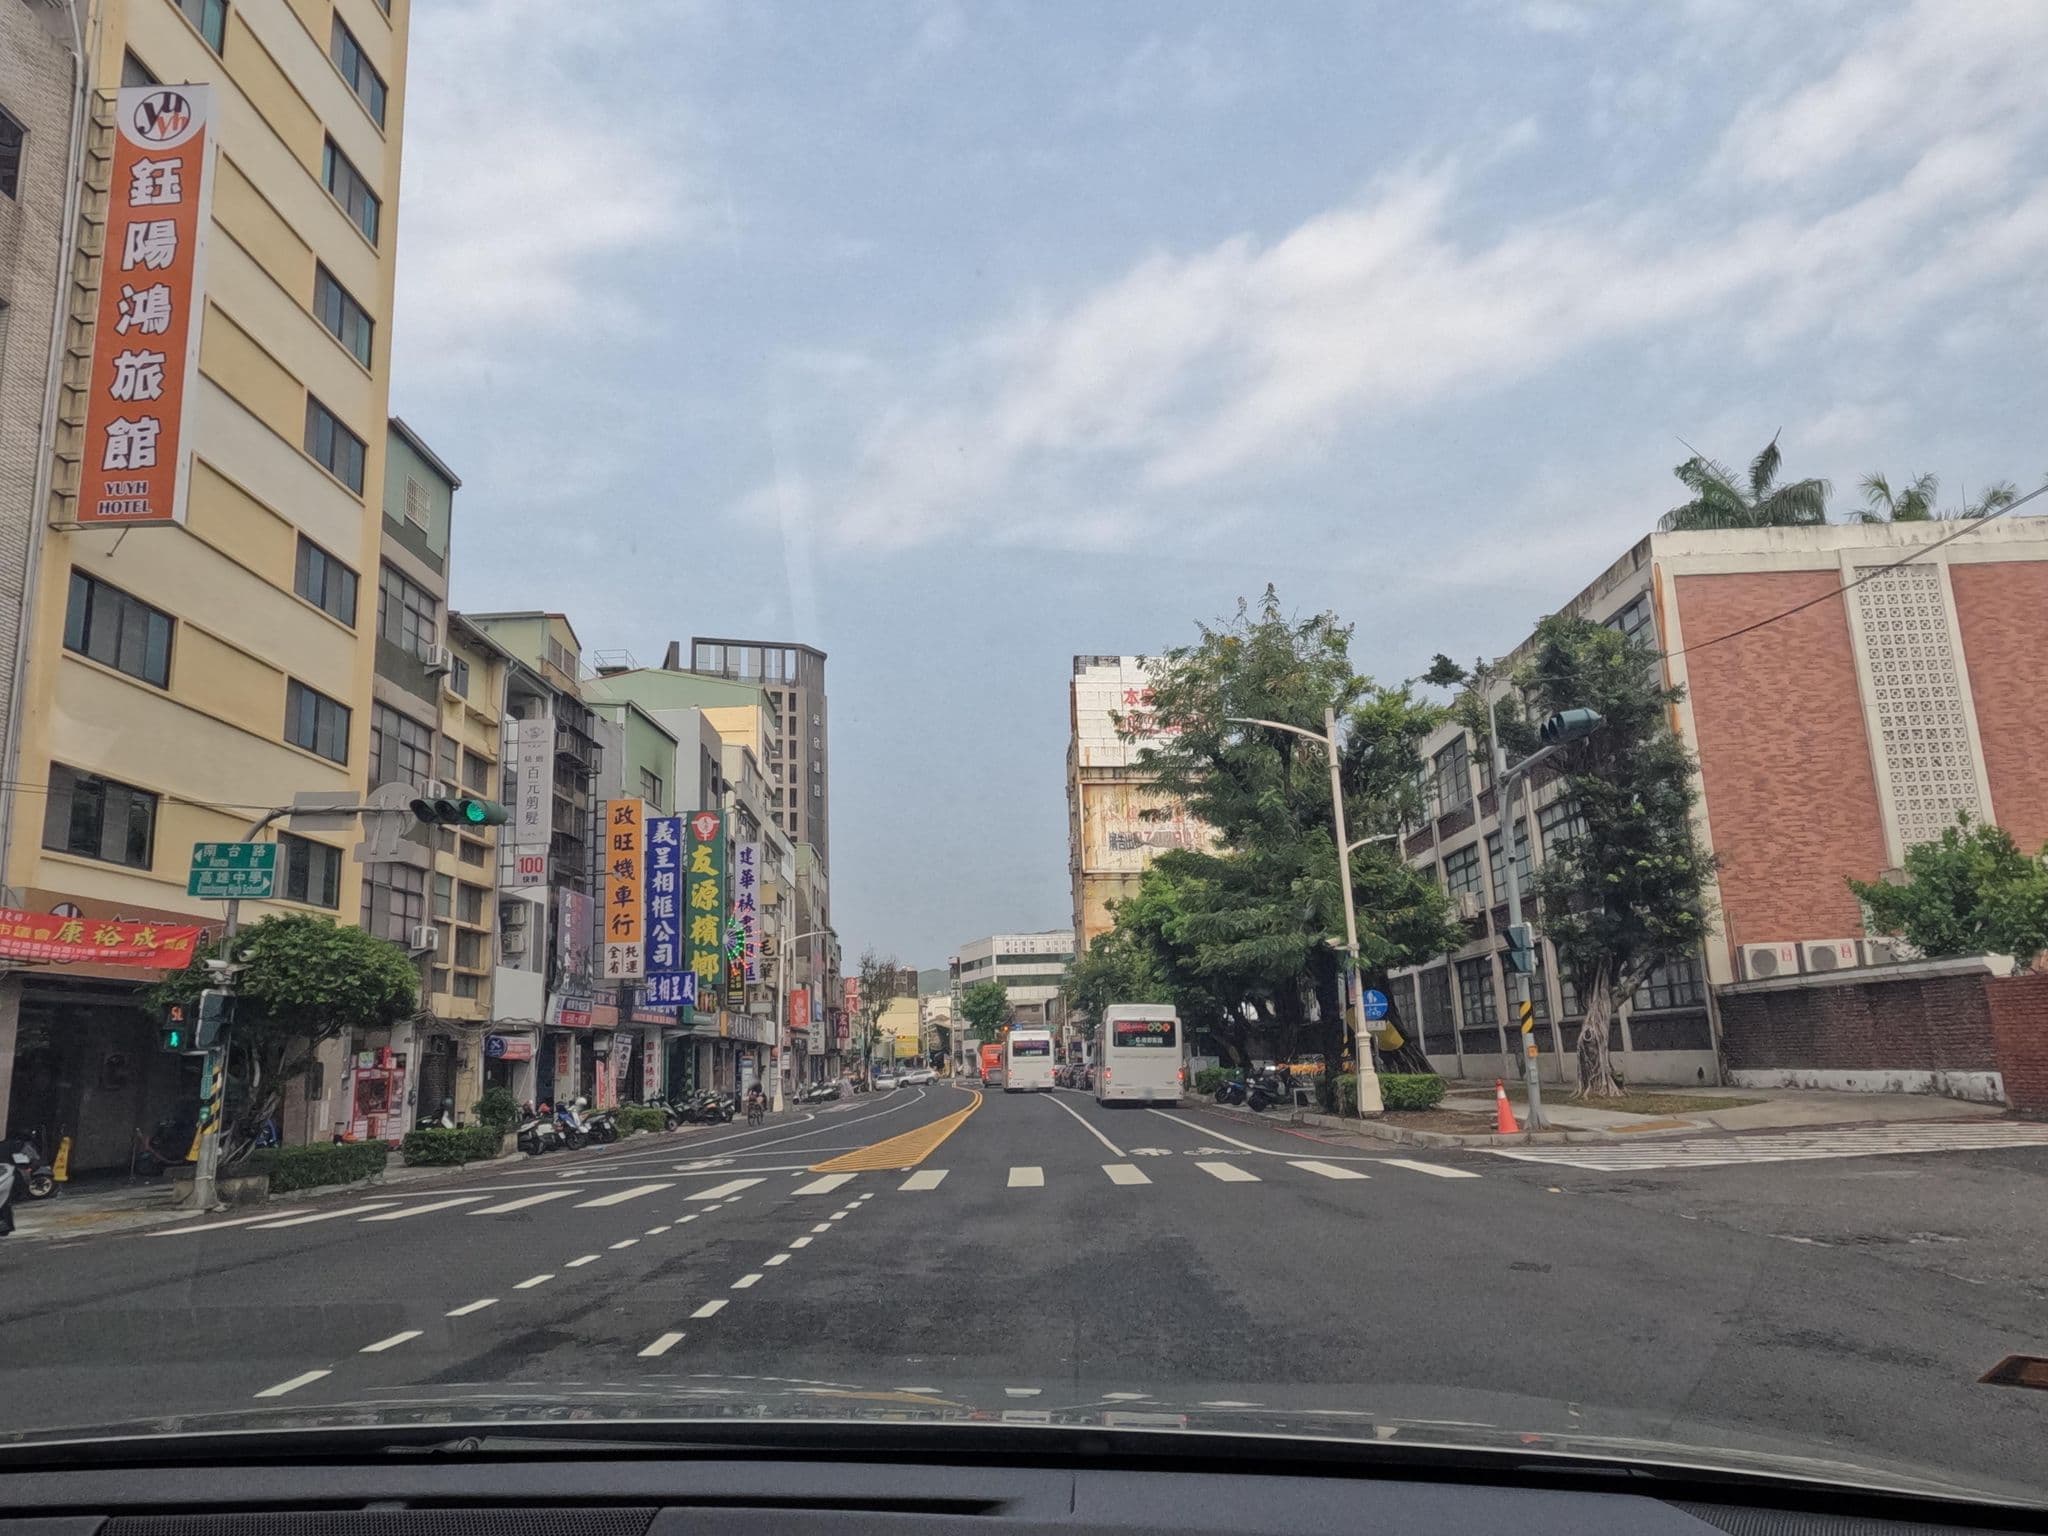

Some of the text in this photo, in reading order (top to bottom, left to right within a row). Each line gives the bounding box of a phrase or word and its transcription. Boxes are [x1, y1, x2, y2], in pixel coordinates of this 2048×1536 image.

[102, 157, 183, 471] 鈺陽鴻旅館
[105, 481, 149, 496] YUYH
[97, 500, 152, 516] HOTEL
[525, 766, 541, 826] 百元剪髮
[519, 856, 544, 874] 100
[612, 805, 636, 937] 政旺機車行
[652, 821, 678, 967] 義呈相框公司
[690, 845, 720, 983] 友源檳榔
[53, 920, 158, 949] 康裕成
[608, 946, 621, 975] 全省
[625, 945, 640, 974] 托運
